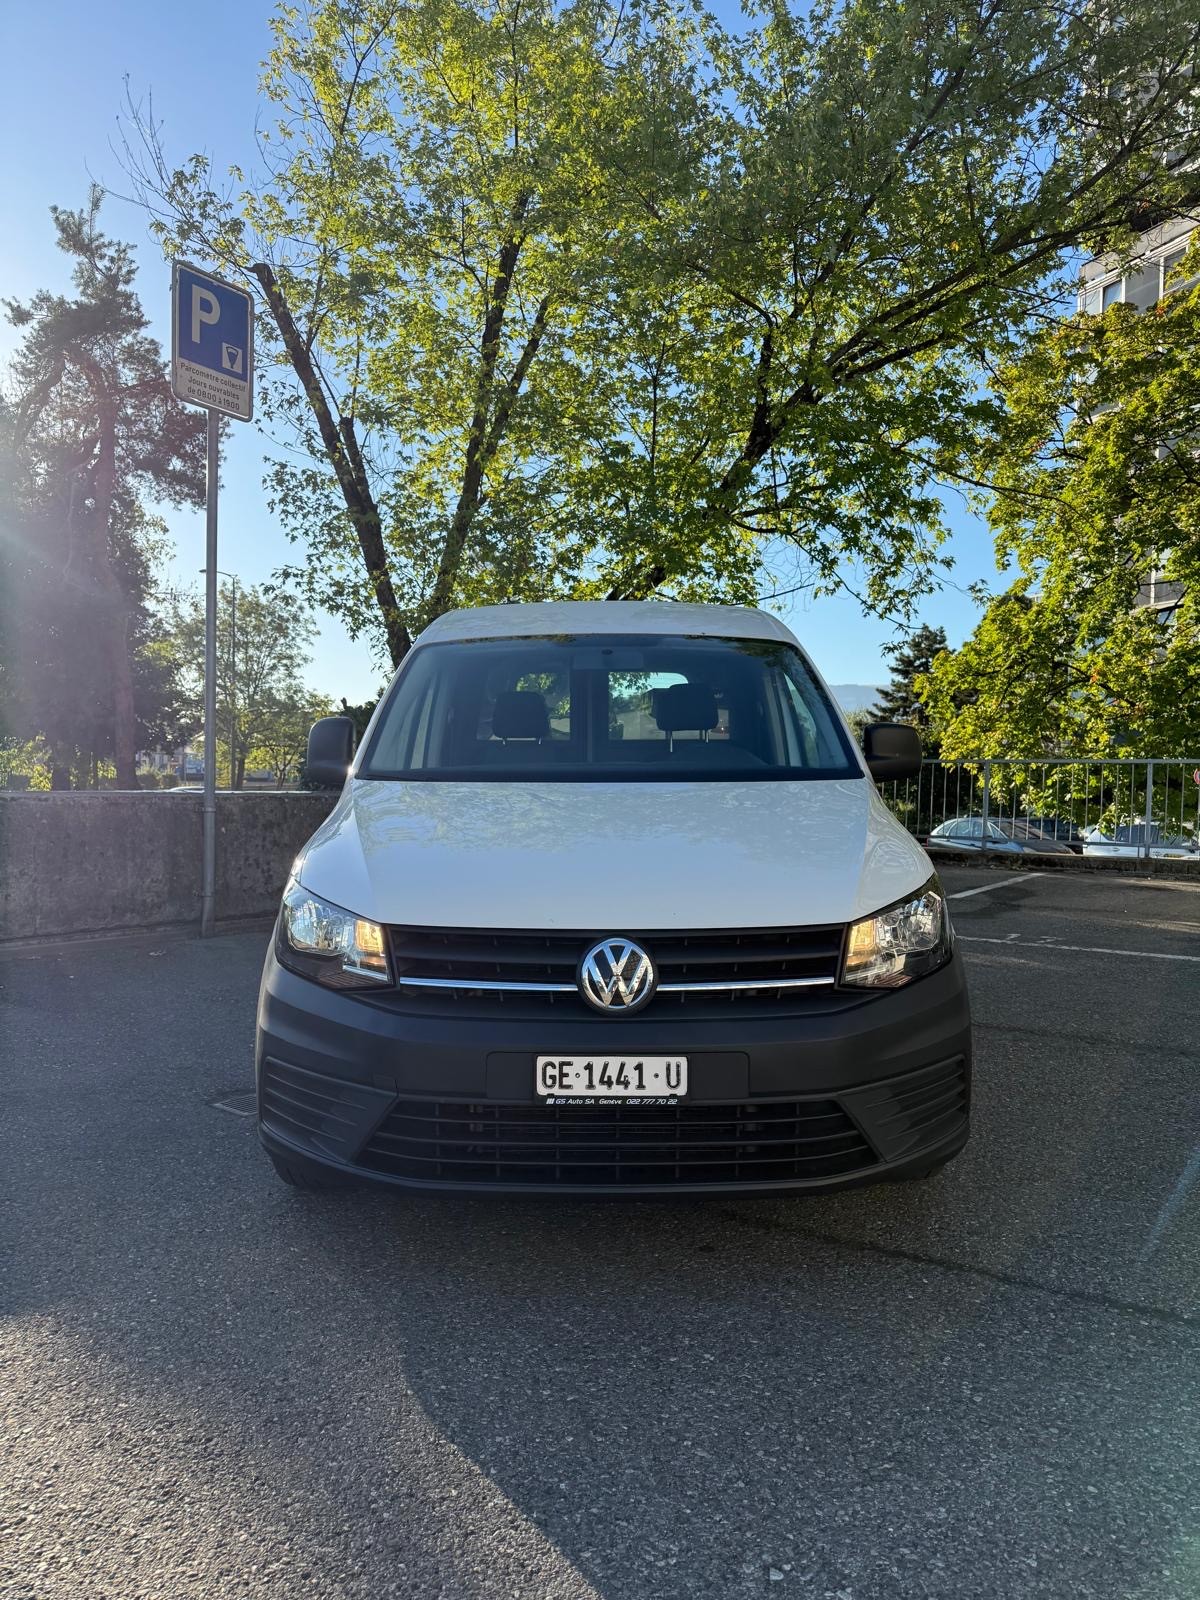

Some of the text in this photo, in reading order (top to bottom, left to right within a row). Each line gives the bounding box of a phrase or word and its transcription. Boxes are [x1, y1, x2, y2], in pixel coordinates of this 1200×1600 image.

[191, 283, 221, 344] P
[188, 376, 240, 400] Jours ouvrables
[220, 377, 246, 392] collectif
[187, 386, 196, 395] de
[197, 389, 217, 403] 0800
[223, 398, 240, 410] 1900
